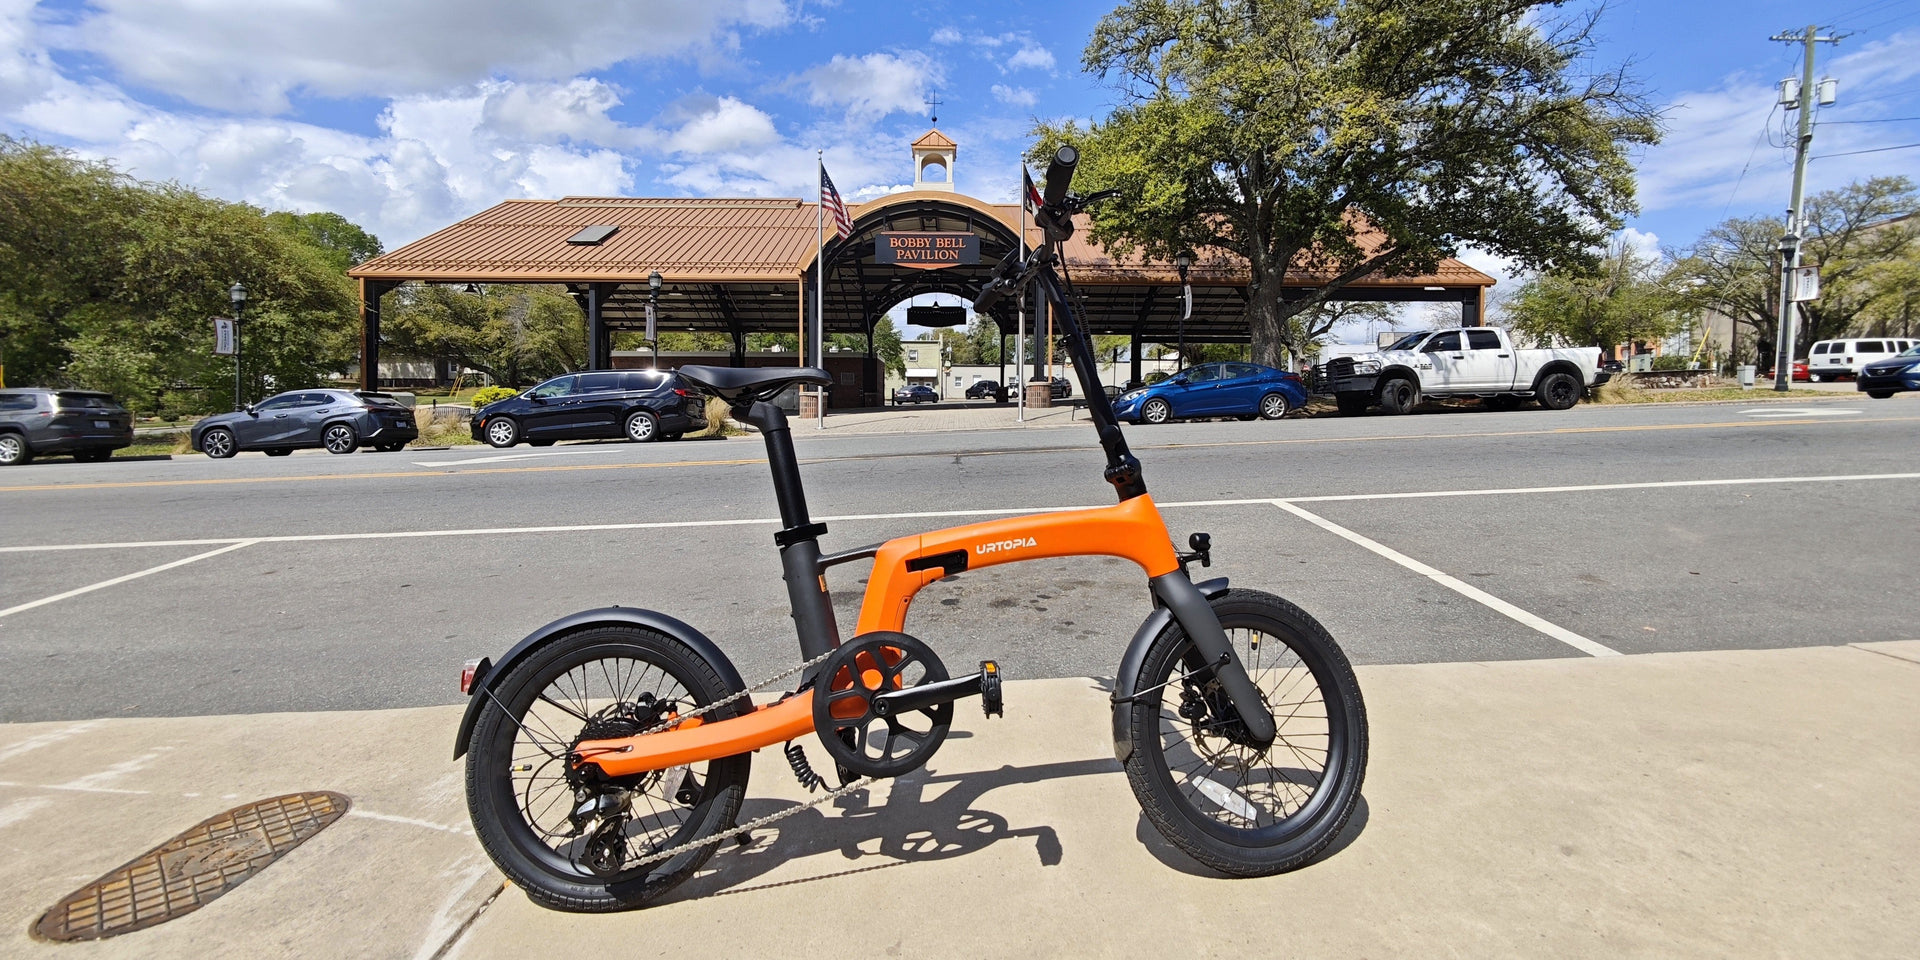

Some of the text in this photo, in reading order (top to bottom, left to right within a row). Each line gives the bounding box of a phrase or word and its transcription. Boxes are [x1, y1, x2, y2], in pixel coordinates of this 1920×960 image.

[889, 237, 967, 248] BOBBY BELL
[896, 249, 959, 260] PAVILION
[976, 536, 1037, 555] URTOPIA
